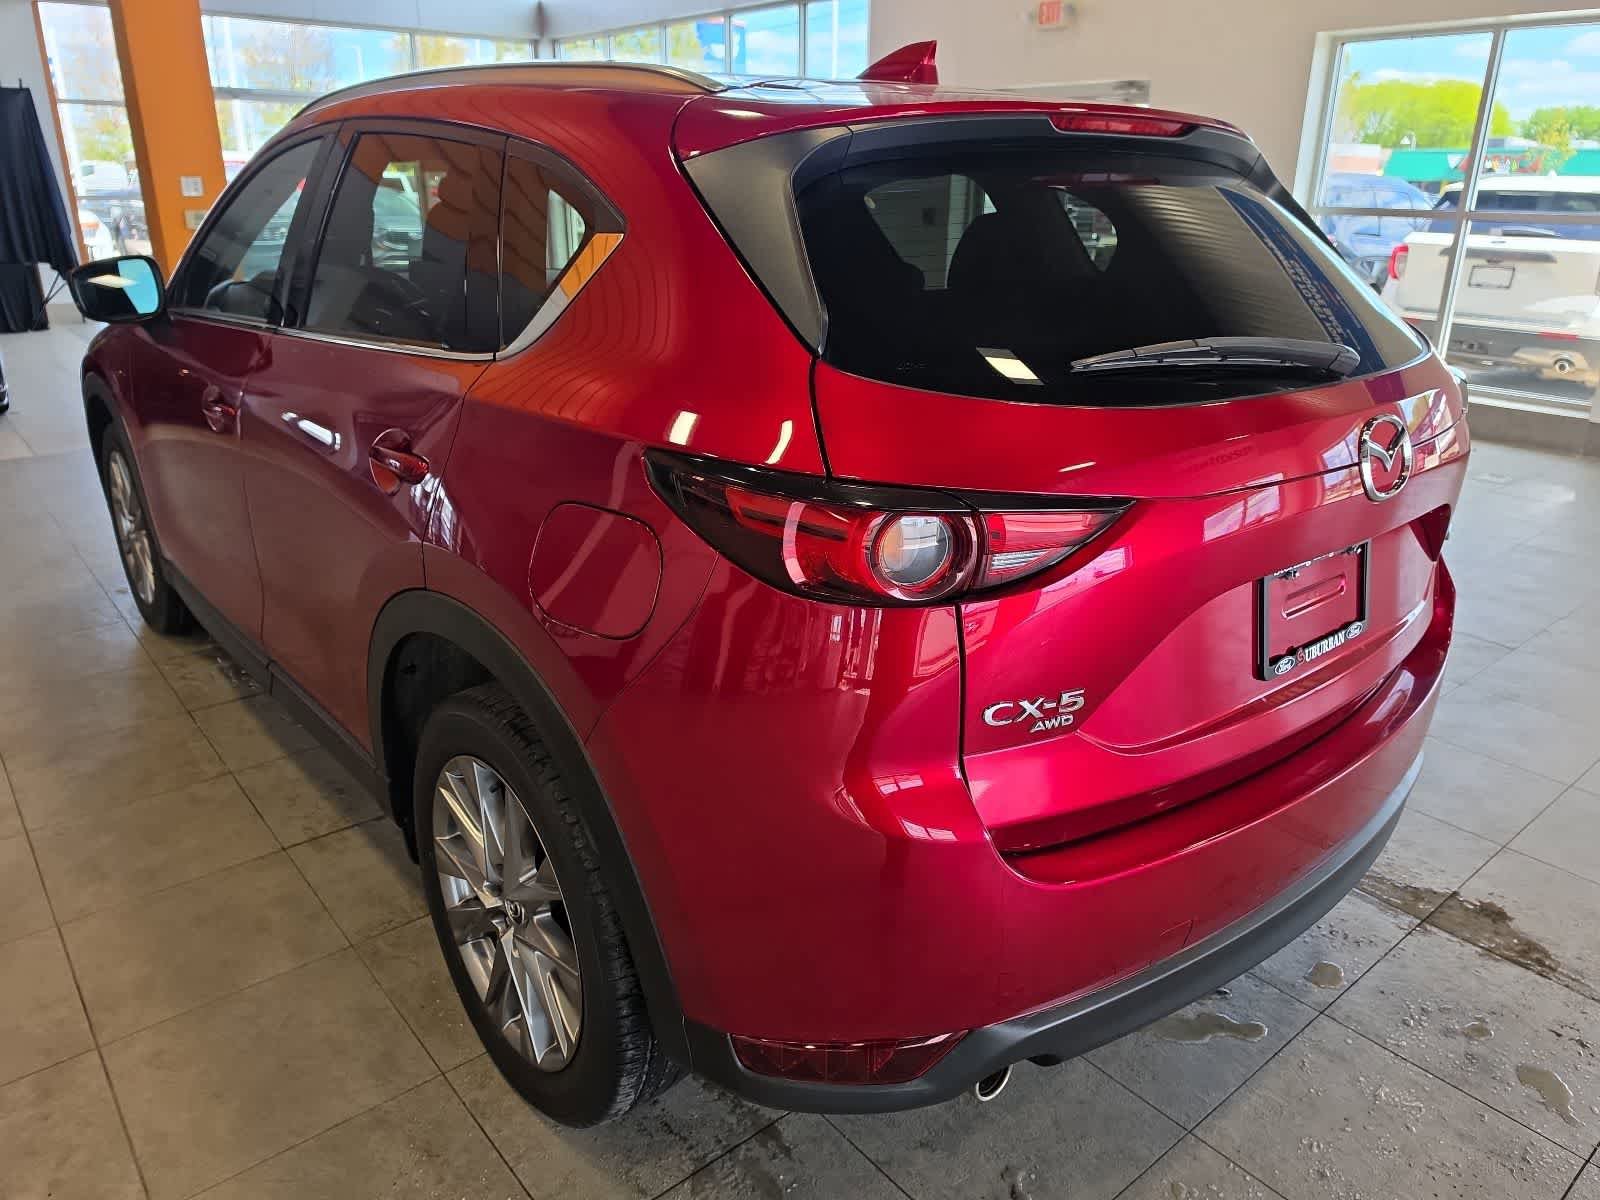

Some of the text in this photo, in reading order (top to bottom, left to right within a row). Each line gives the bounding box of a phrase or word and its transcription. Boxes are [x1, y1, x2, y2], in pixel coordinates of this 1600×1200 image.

[1297, 630, 1345, 665] SUBURBAN
[983, 688, 1085, 726] CX-5
[1029, 713, 1074, 733] AWD
